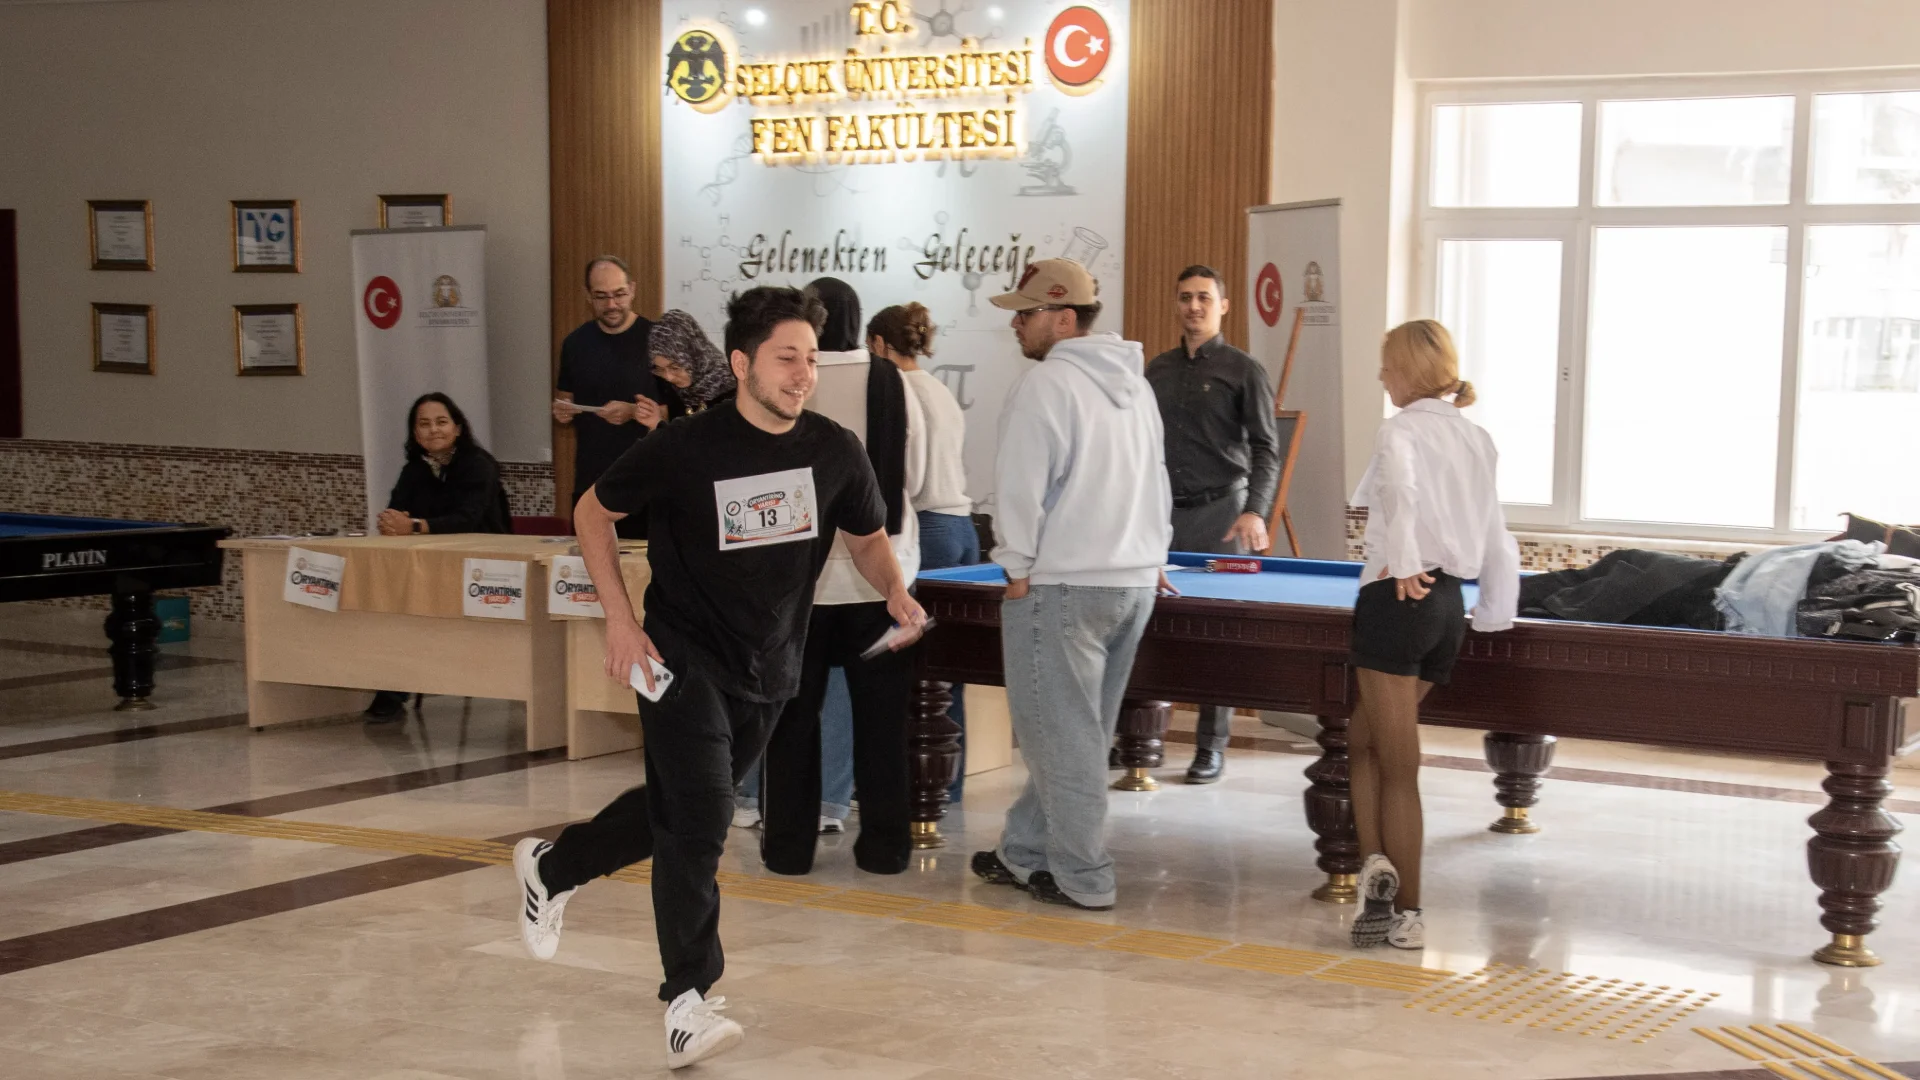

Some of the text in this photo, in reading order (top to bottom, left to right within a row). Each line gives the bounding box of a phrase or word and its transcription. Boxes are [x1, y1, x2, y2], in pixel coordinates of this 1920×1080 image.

[853, 1, 909, 35] T.C.
[736, 37, 1033, 104] SELÇUK ÜNİVERSİTESİ
[750, 95, 1016, 153] FEN FAKÜLTESİ
[739, 227, 1036, 291] Gelenekten Geleceğe
[759, 508, 778, 527] 13
[42, 549, 108, 568] PLATİN
